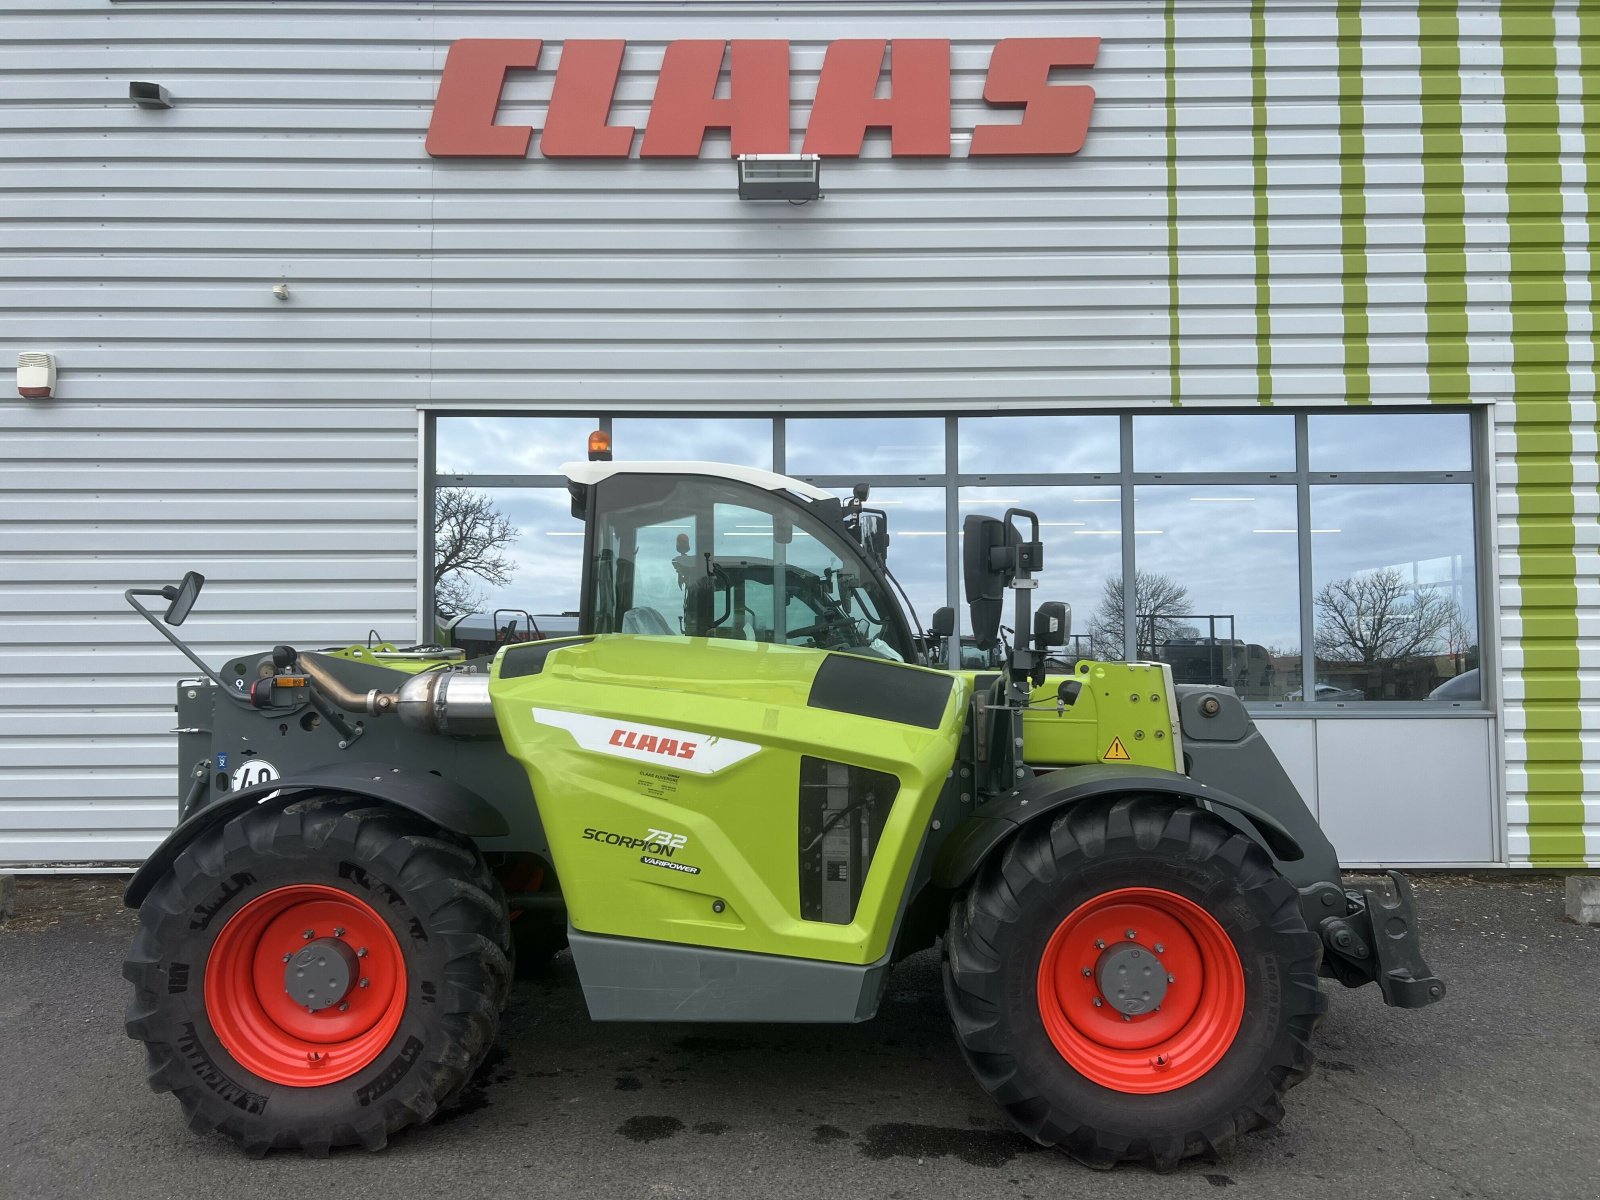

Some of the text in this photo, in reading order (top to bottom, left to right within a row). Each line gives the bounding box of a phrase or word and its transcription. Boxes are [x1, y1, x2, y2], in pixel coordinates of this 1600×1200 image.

[425, 37, 1101, 158] CLAAS
[609, 729, 697, 760] CLAAS
[582, 828, 676, 857] SCORPION
[644, 828, 688, 849] 732
[644, 857, 698, 874] VARIPOWER
